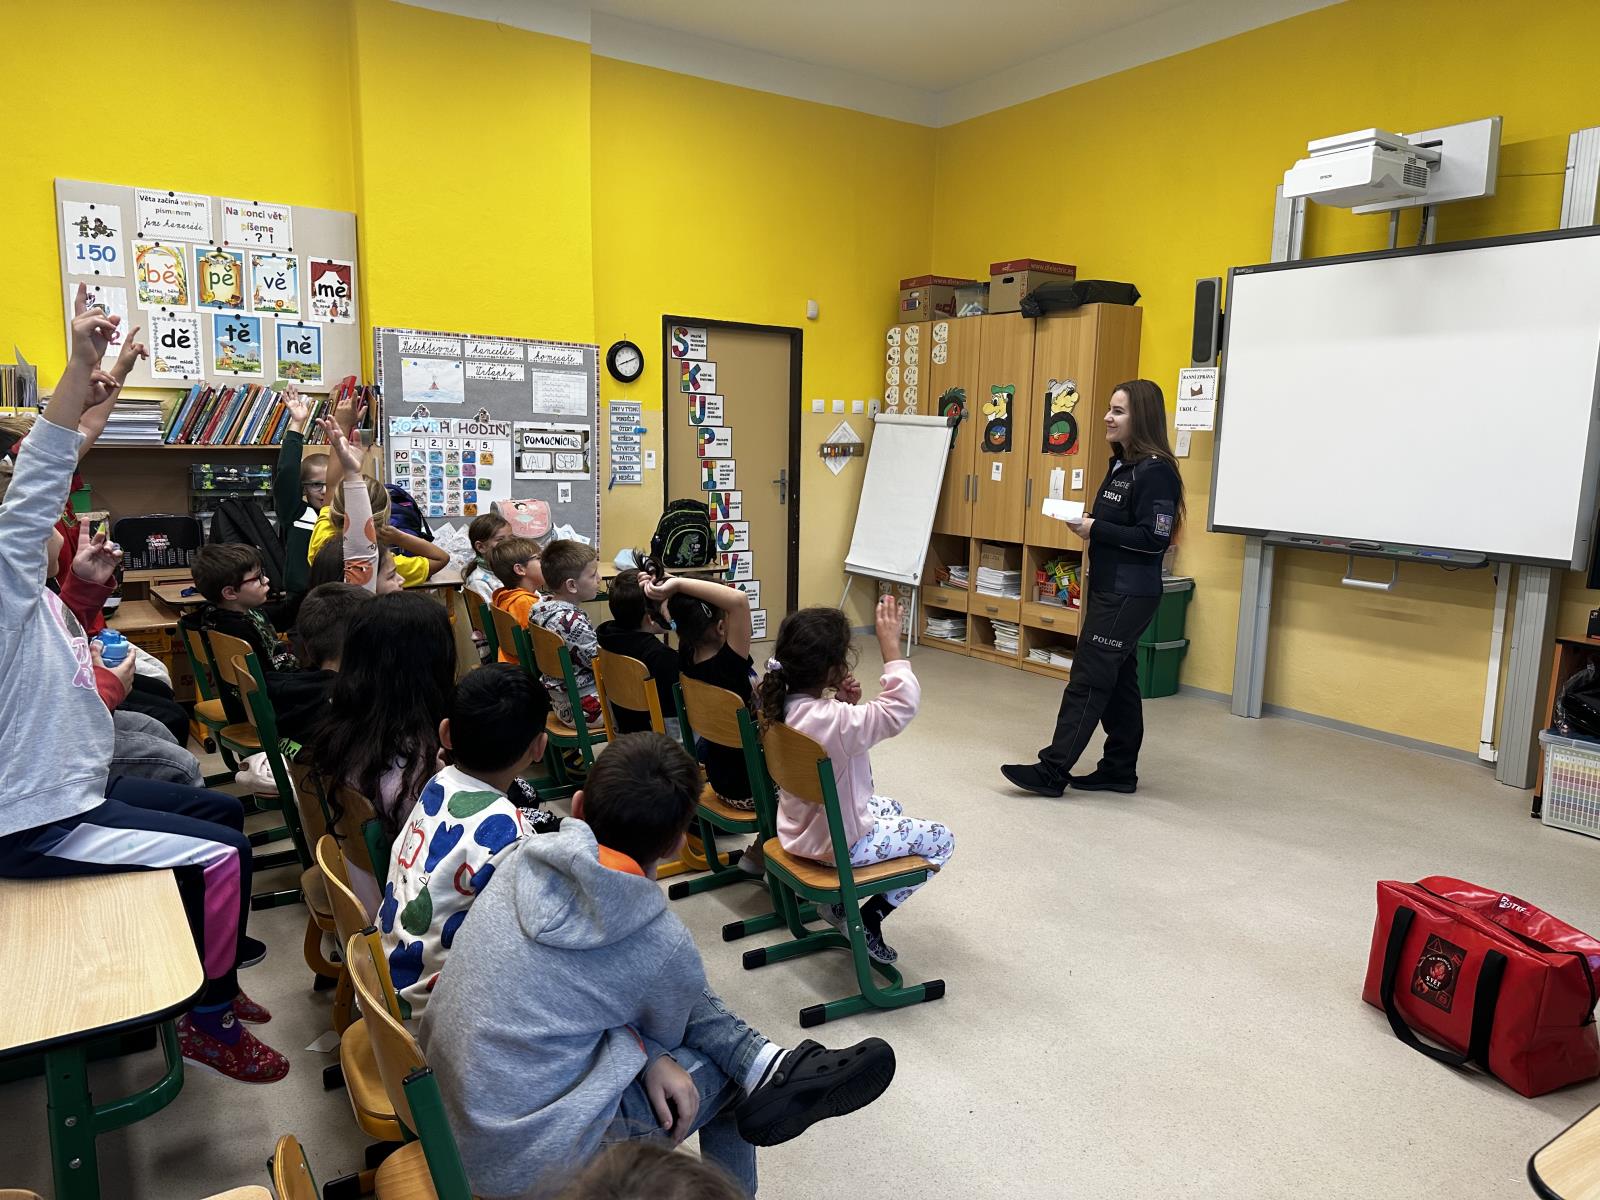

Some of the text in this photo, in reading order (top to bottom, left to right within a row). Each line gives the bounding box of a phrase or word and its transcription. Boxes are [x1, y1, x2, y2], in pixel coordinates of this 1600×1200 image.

[140, 195, 156, 203] Věta
[225, 206, 289, 223] Na konci věty
[240, 221, 274, 233] píšeme
[76, 243, 116, 263] 150
[146, 262, 177, 285] bě
[209, 264, 234, 290] pě
[263, 271, 287, 291] vě
[318, 279, 346, 298] mě
[161, 328, 191, 349] dě
[225, 322, 251, 343] tě
[287, 335, 312, 354] ně
[471, 344, 515, 356] kancelář
[459, 422, 506, 436] HODIN
[414, 439, 491, 450] 1. 2. 3. 4. 5.
[395, 451, 408, 460] PO
[396, 463, 409, 474] ÚT
[397, 480, 409, 488] ST
[1092, 634, 1123, 648] POLICIE
